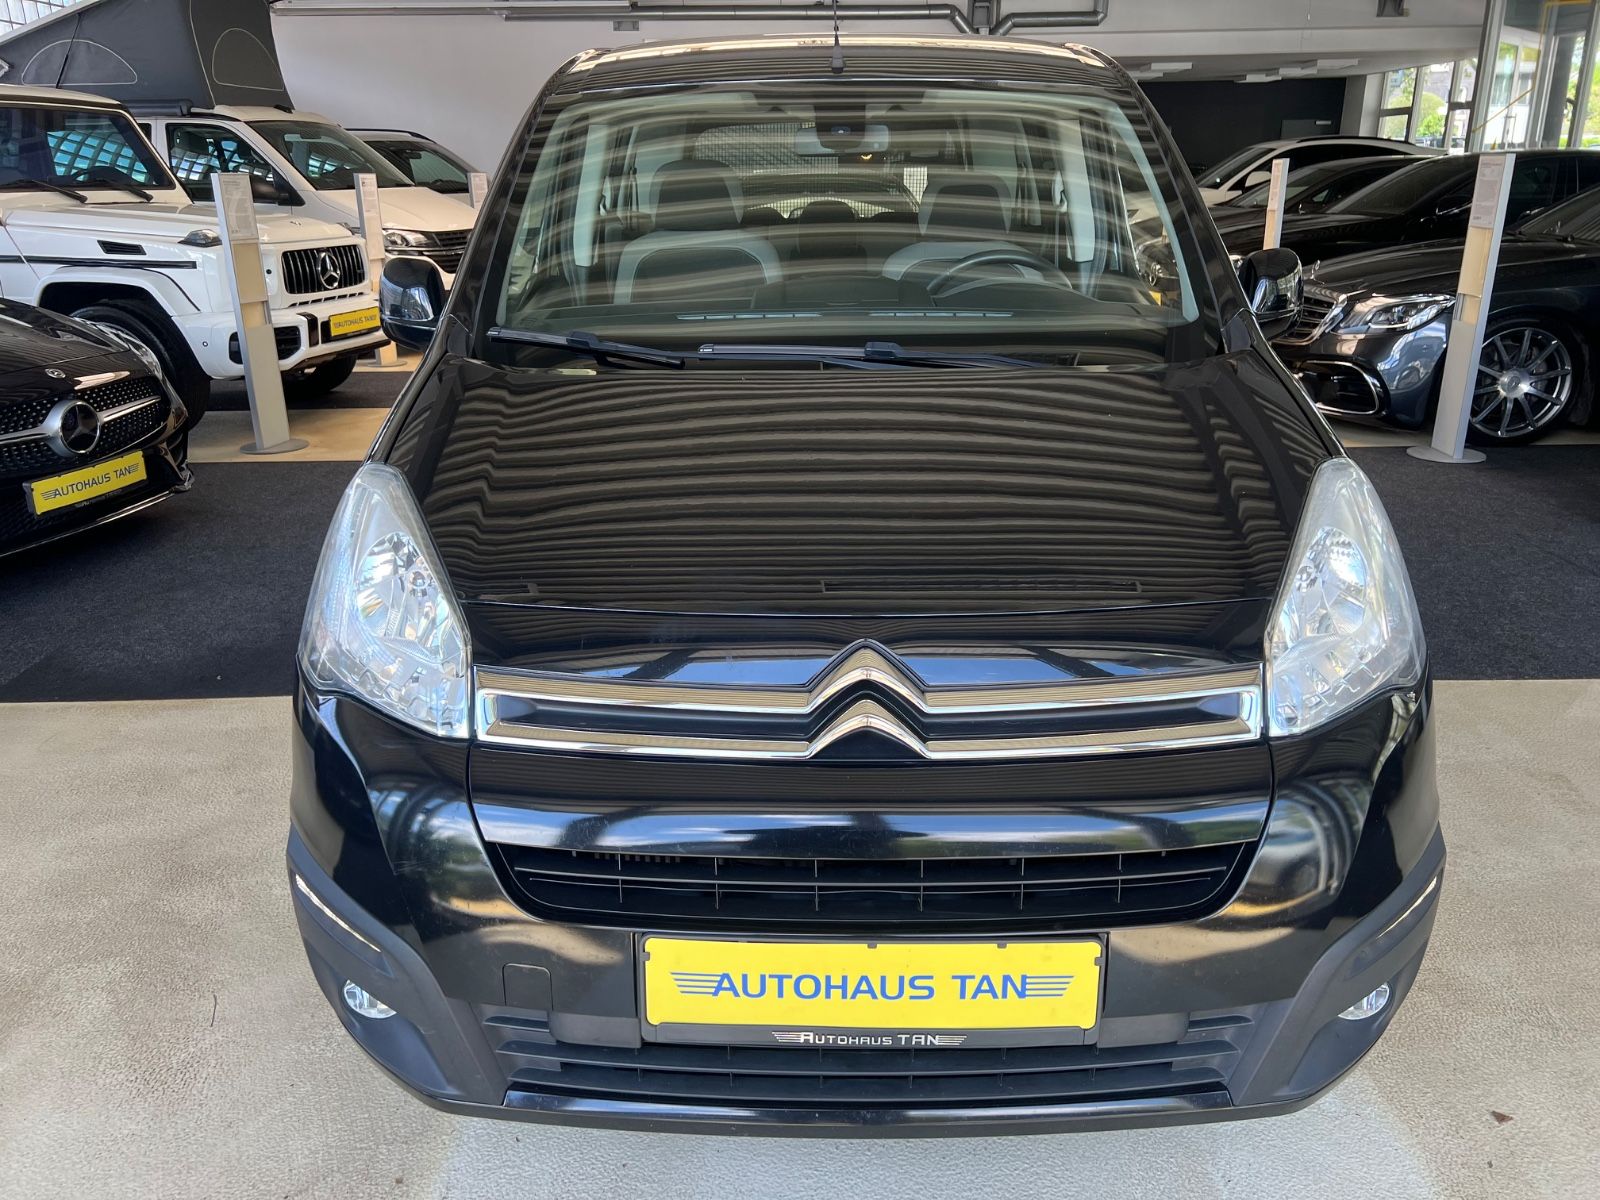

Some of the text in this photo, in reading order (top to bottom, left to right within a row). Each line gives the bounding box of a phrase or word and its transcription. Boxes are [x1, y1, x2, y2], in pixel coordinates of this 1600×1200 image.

[54, 465, 132, 498] AUTOHAUS TAN
[712, 972, 1027, 1000] AUTOHAUS TAN
[897, 1034, 940, 1046] TAN
